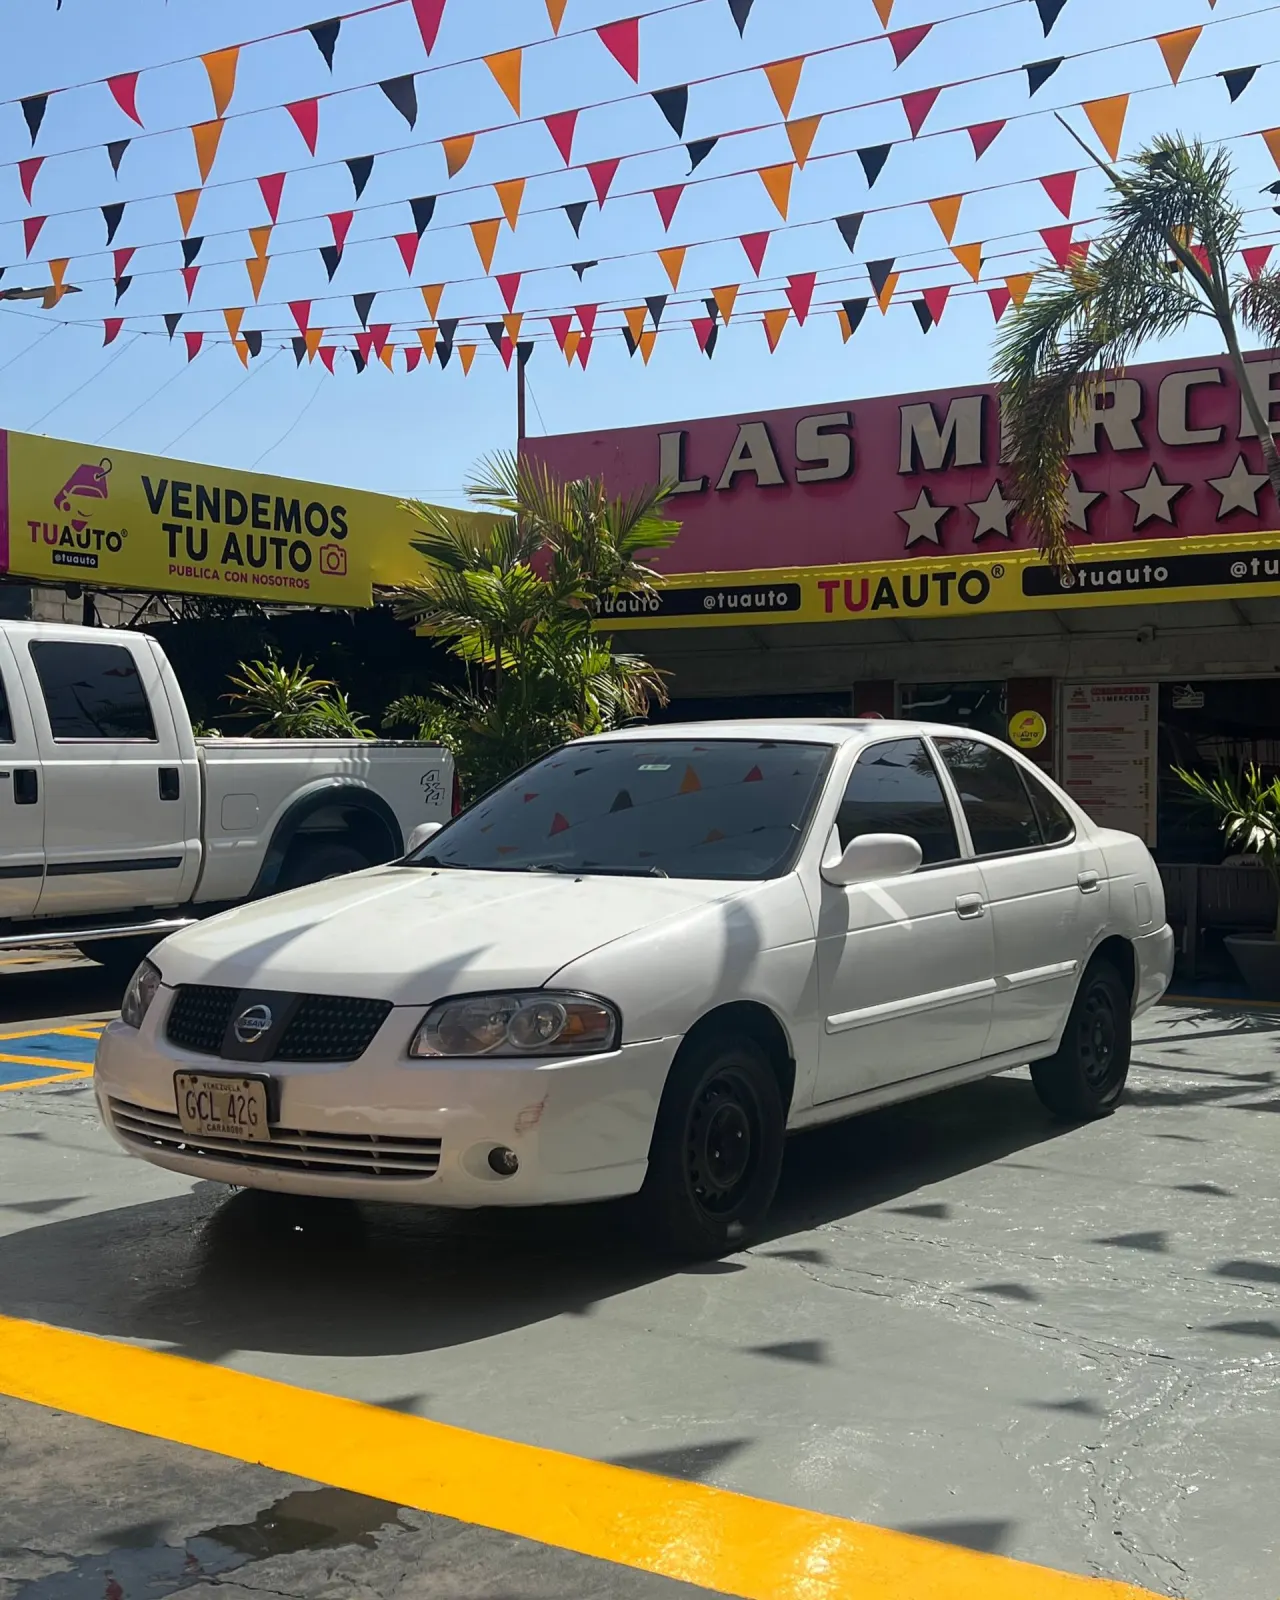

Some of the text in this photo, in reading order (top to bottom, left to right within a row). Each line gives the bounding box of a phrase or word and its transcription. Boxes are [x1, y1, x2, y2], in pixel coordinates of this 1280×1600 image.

[657, 358, 1280, 495] LAS MRCE
[141, 475, 348, 540] VENDEMOS
[54, 553, 96, 566] @tuauto
[162, 523, 312, 573] TU AUTO
[168, 564, 310, 589] PUBLICA CON NOSOTROS
[1060, 565, 1169, 589] @tuauto
[703, 590, 788, 610] @tuauto
[202, 1082, 241, 1092] VENEZUELA
[186, 1090, 258, 1126] GCL 42G
